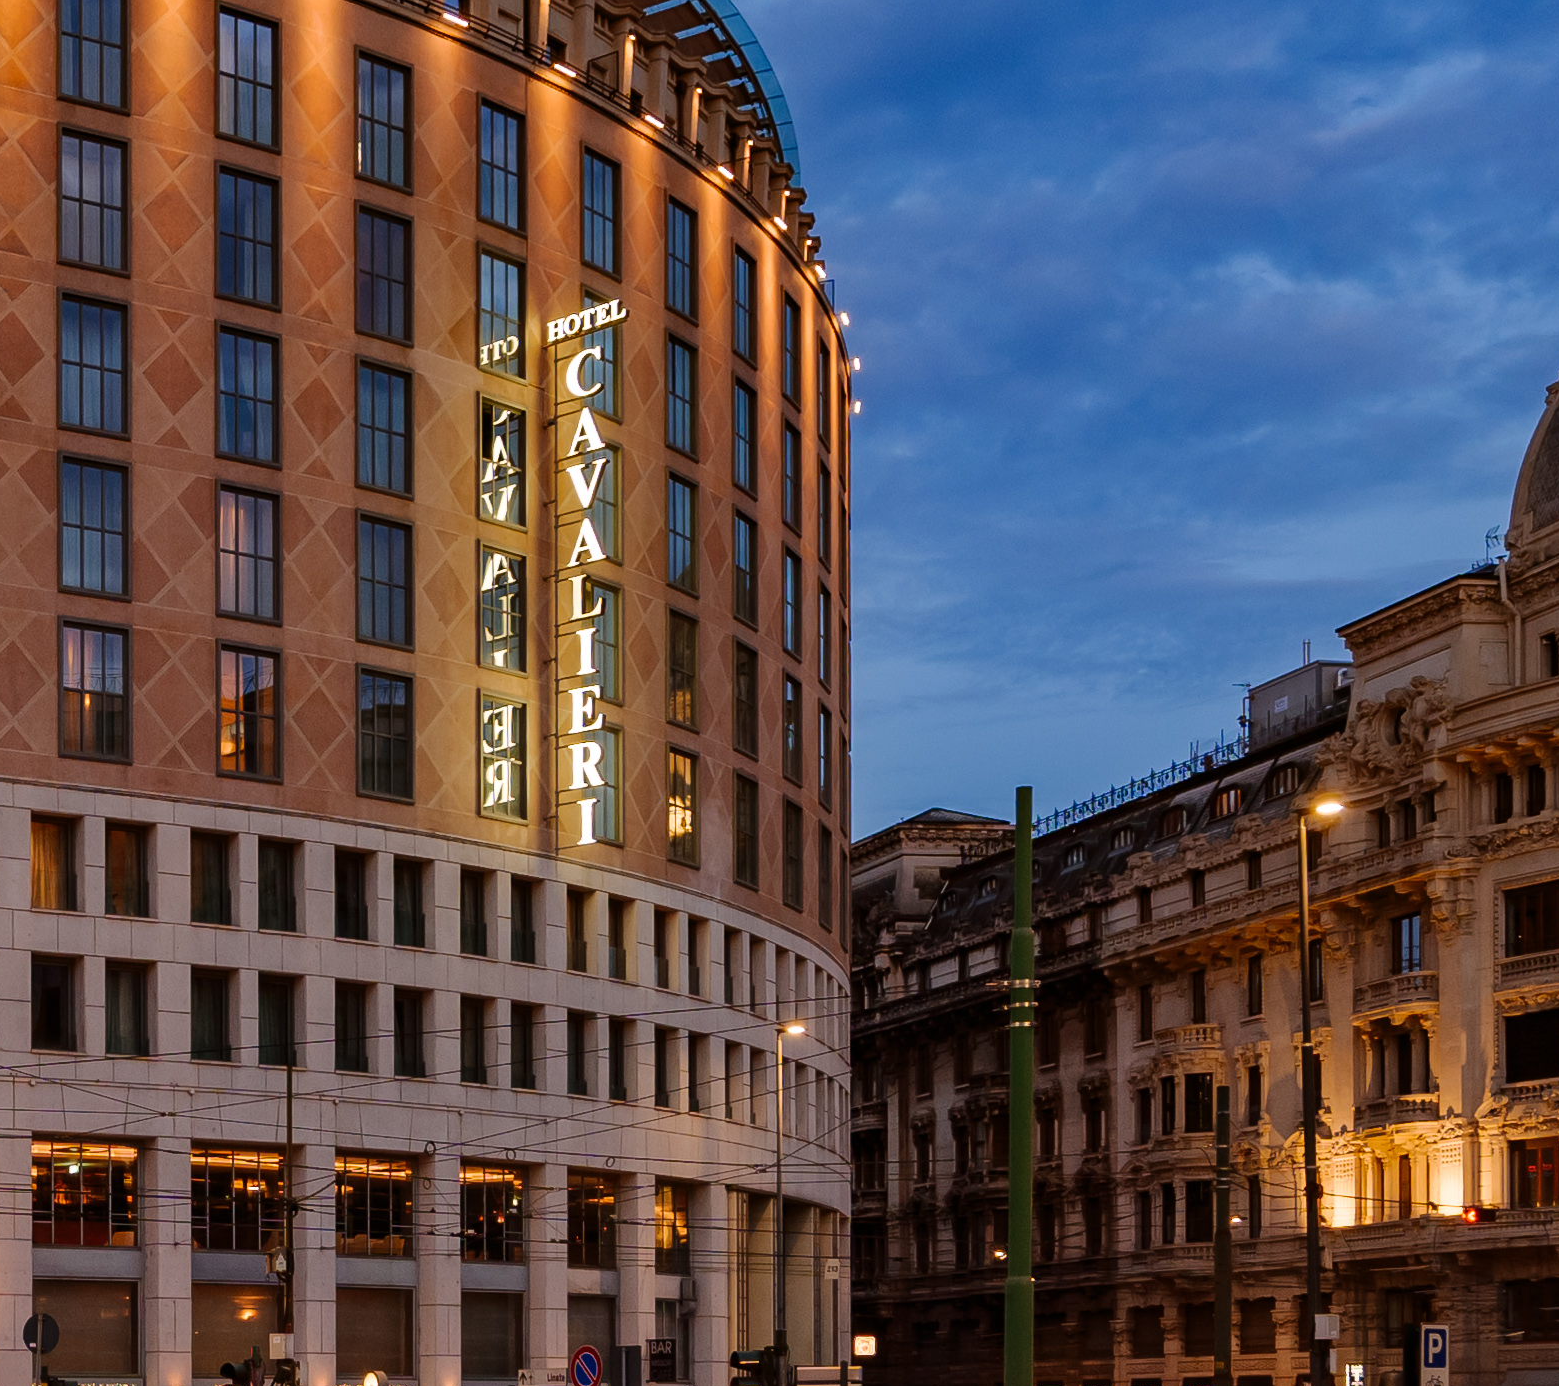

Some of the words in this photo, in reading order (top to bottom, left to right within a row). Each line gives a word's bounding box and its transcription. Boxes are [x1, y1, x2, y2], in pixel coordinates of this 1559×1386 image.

[546, 298, 627, 343] HOTEL
[565, 345, 608, 846] CAVALIERI
[650, 1341, 672, 1355] BAR
[1428, 1332, 1443, 1364] P
